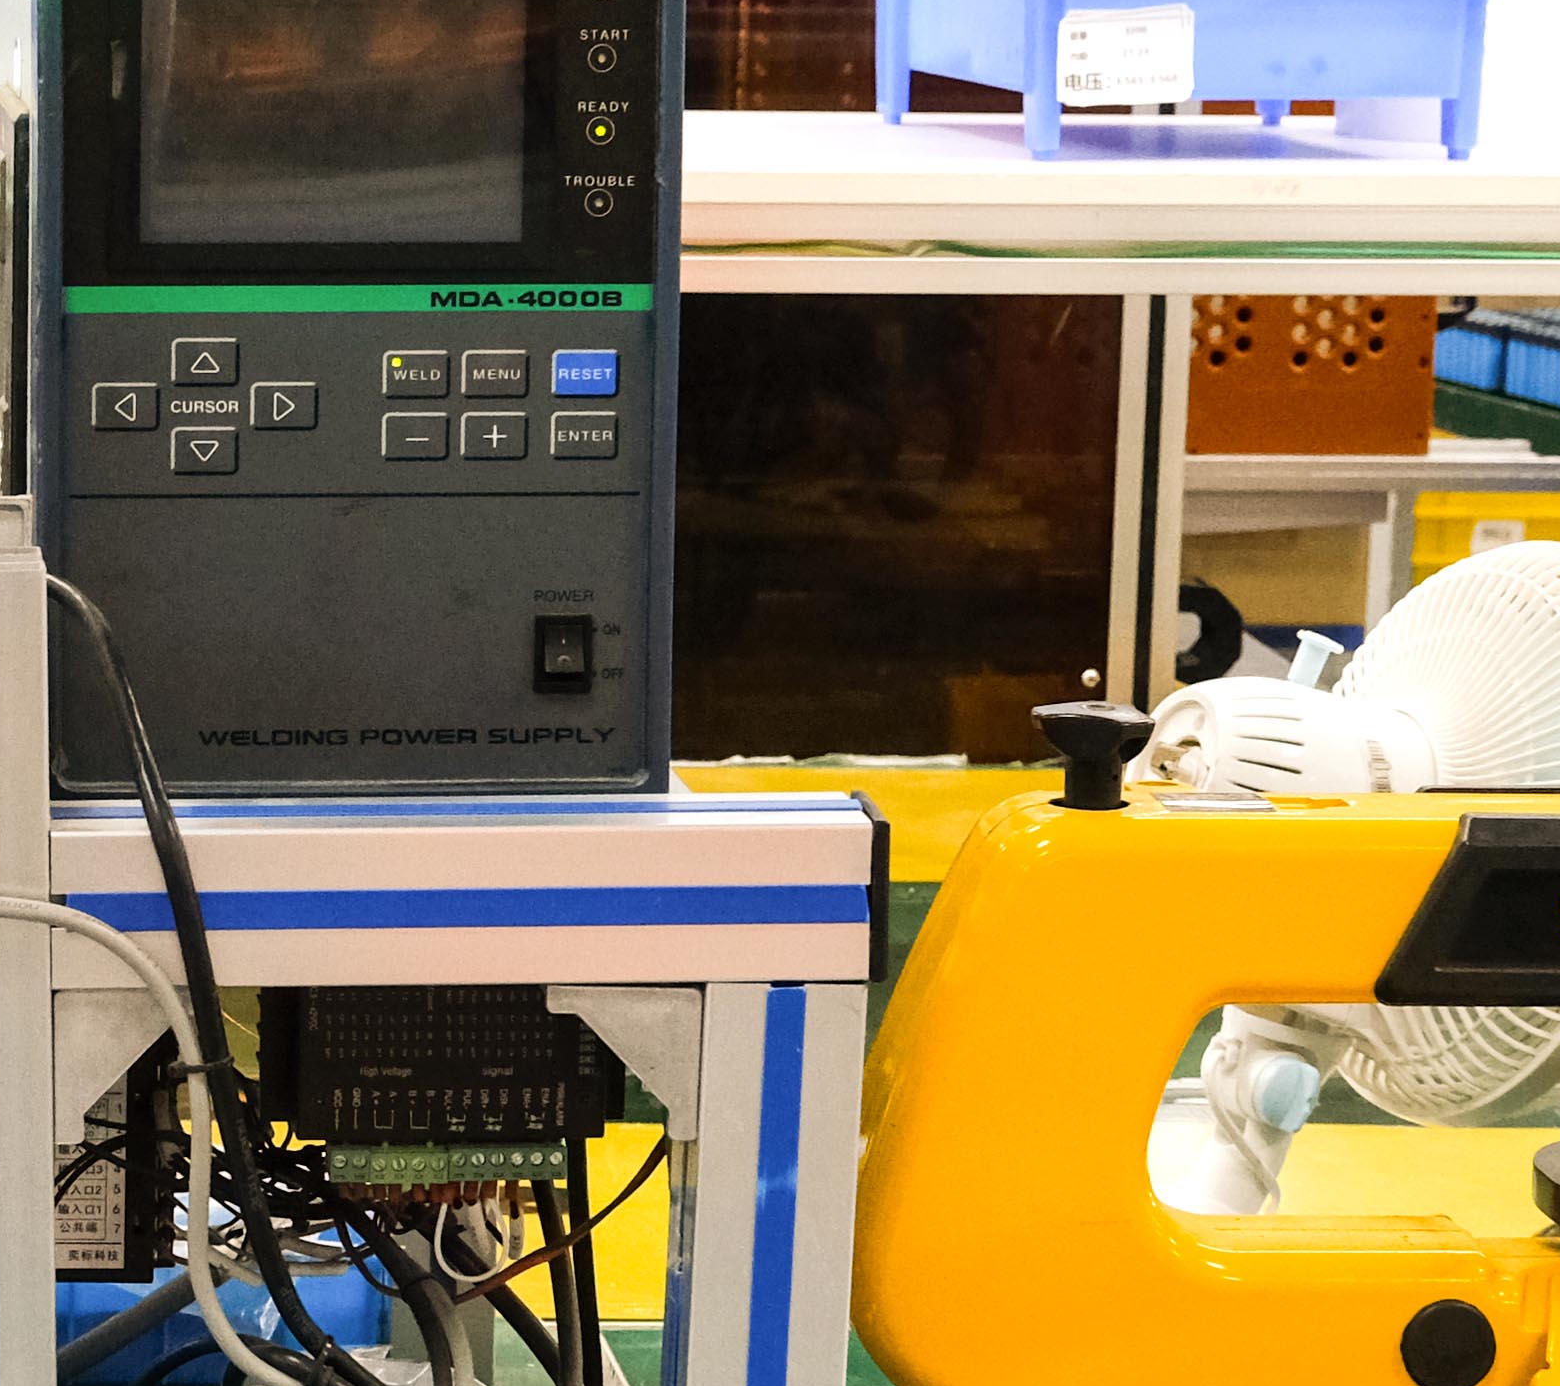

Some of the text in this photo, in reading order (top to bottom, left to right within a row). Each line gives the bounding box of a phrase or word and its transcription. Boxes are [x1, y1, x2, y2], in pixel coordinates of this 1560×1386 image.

[579, 28, 630, 41] START
[576, 101, 631, 114] READY
[564, 174, 636, 188] TROUBLE
[392, 368, 442, 382] WELD
[472, 368, 522, 381] MENU
[557, 367, 613, 381] RESET
[170, 399, 240, 414] CURSOR
[557, 429, 614, 442] ENTER
[533, 589, 595, 603] POWER
[601, 624, 622, 636] ON
[601, 668, 625, 680] OFF
[198, 726, 617, 747] WELDING POWER SUPPLY
[112, 1183, 121, 1195] 5
[112, 1203, 120, 1215] 6
[113, 1222, 121, 1235] 7
